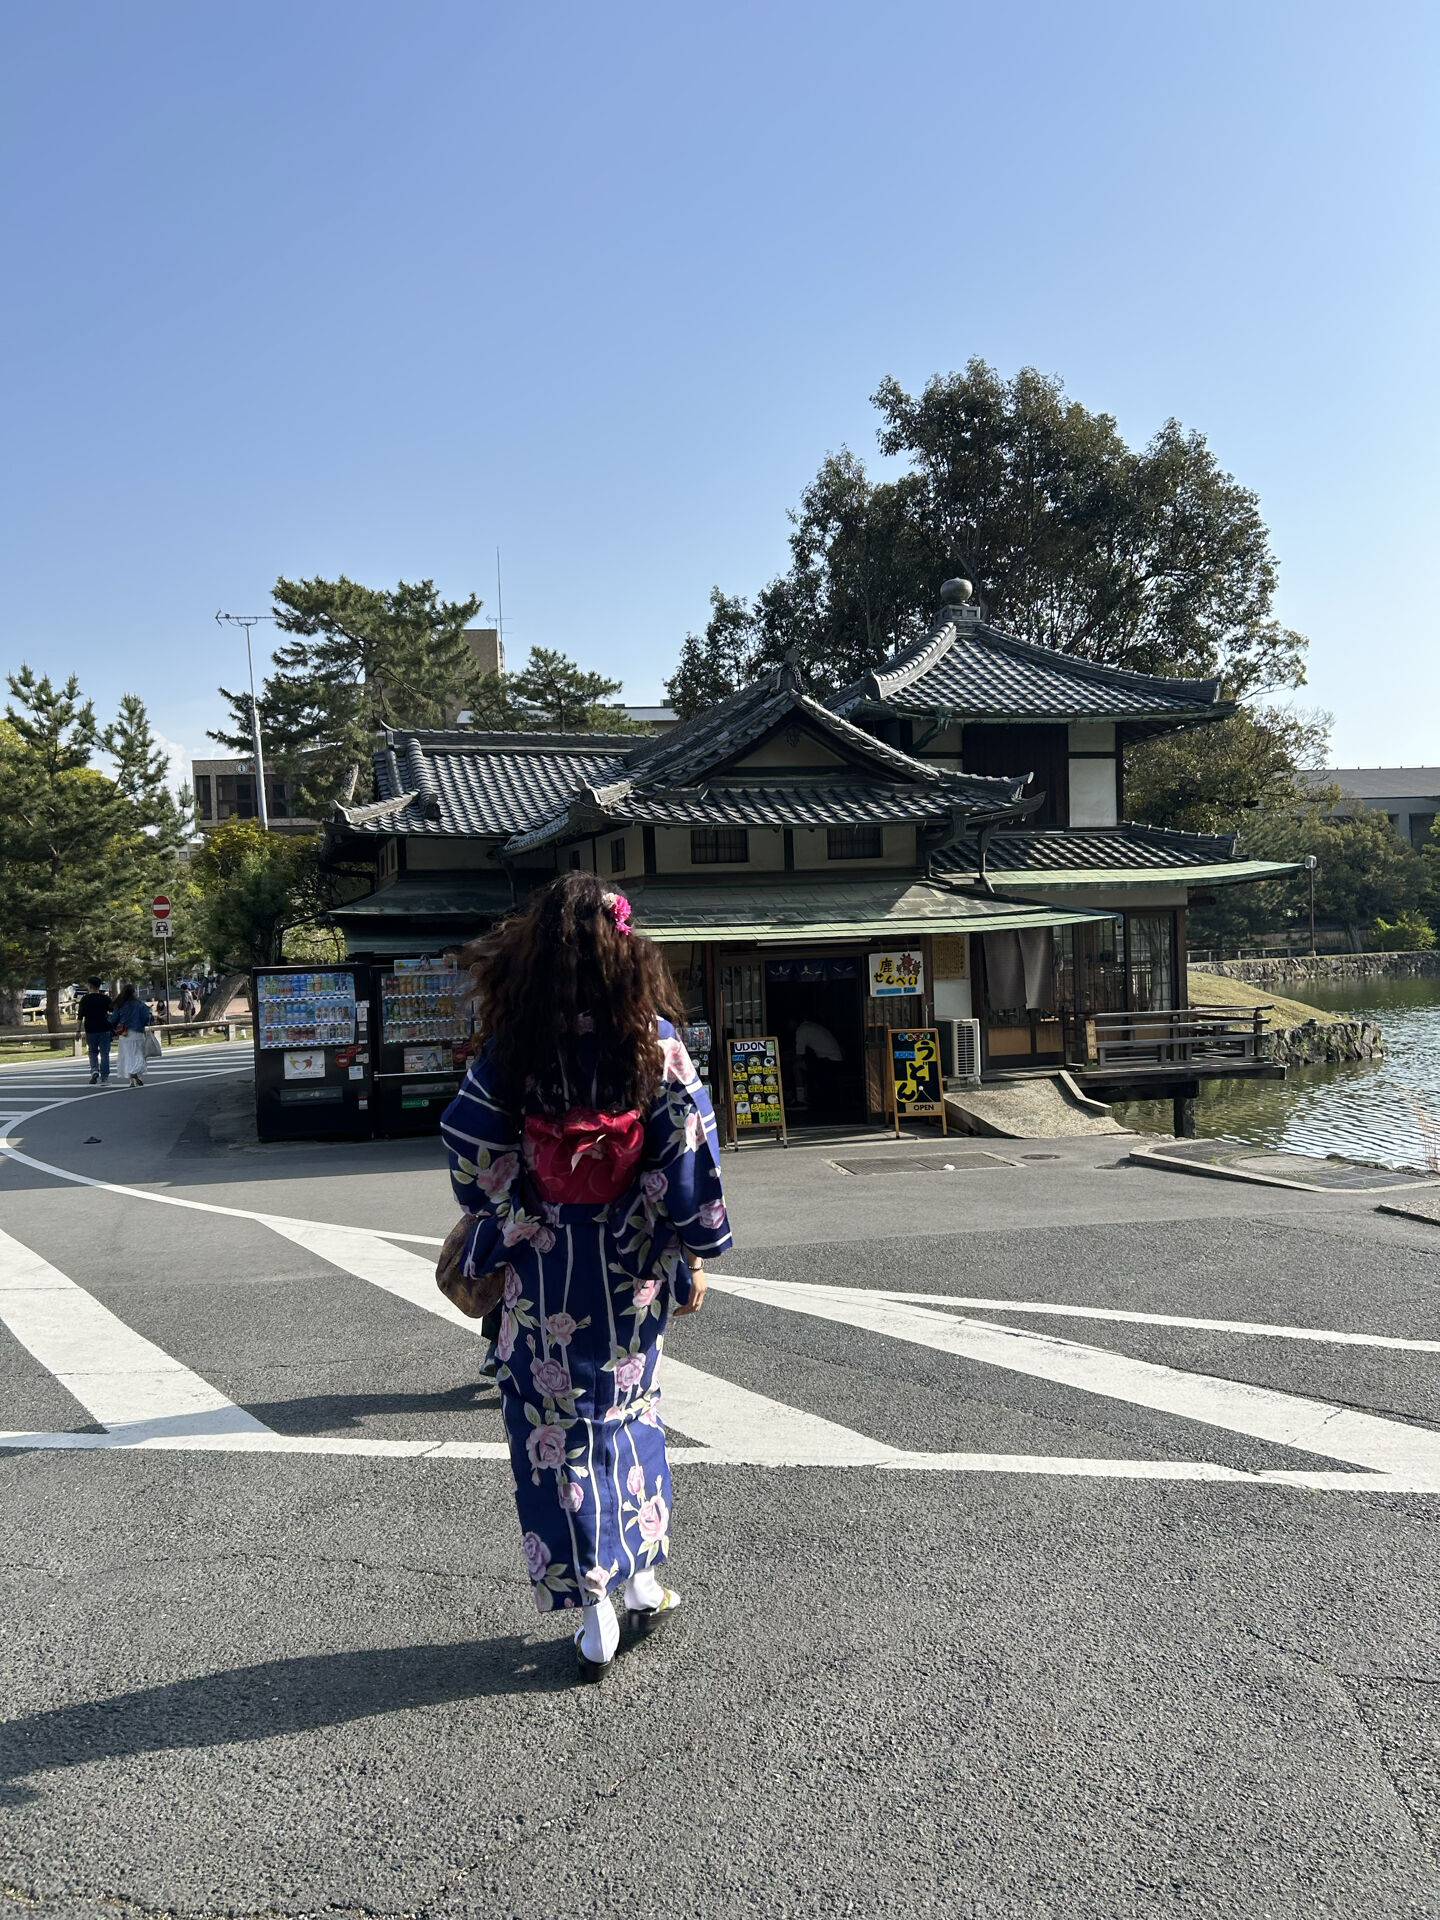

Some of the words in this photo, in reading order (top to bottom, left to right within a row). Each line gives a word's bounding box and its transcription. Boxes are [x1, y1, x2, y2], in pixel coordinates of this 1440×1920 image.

[880, 957, 893, 973] 鹿
[873, 972, 918, 986] せんべい
[734, 1041, 766, 1052] UDON
[896, 1040, 935, 1101] うどん
[913, 1104, 935, 1112] OPEN
